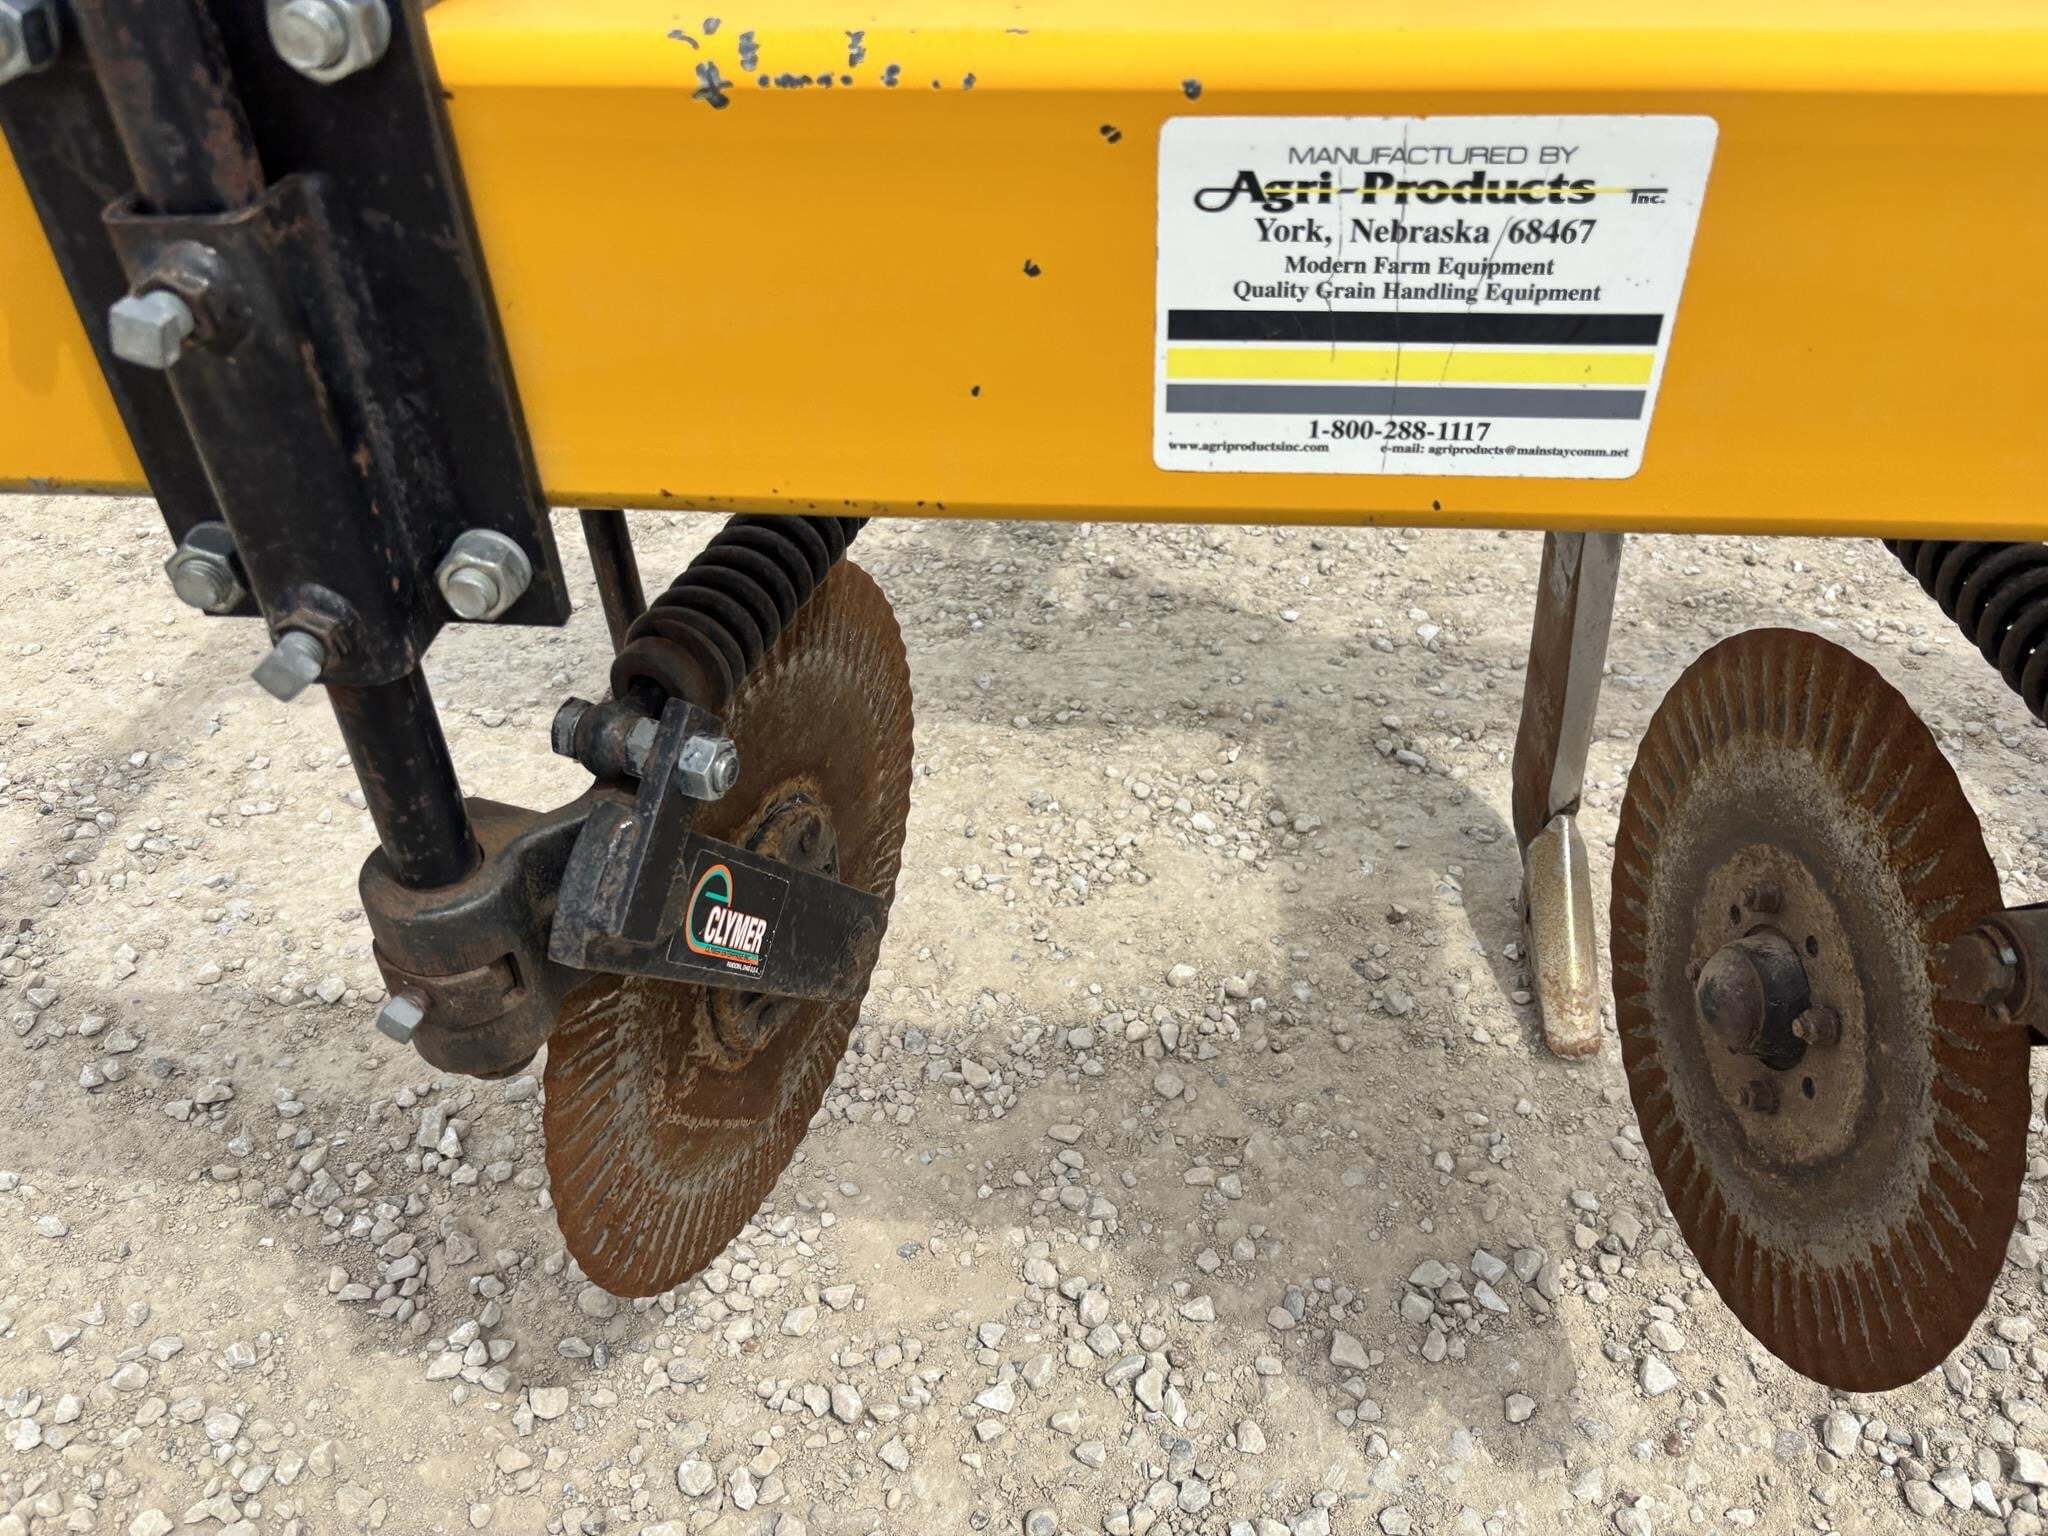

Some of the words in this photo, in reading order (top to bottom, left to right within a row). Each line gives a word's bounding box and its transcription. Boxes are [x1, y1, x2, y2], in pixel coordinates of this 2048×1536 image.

[1288, 146, 1528, 165] MANUFACTURED
[1539, 145, 1580, 165] BY
[1194, 170, 1597, 213] Agri-Products
[1255, 218, 1333, 247] York,
[1349, 218, 1490, 244] Nebraska
[1507, 219, 1597, 245] 68467
[1284, 256, 1366, 275] Modern
[1373, 257, 1431, 276] Farm
[1438, 257, 1554, 279] Equipment
[1233, 281, 1308, 301] Quality
[1316, 282, 1375, 300] Grain
[1383, 282, 1478, 304] Handling
[1485, 283, 1601, 305] Equipment
[1308, 419, 1491, 441] 1-800-288-1117
[1168, 441, 1330, 454] www.agriproductsinc.com
[1380, 443, 1425, 455] e-mail:
[1427, 445, 1630, 459] agriproducts@mainstaycomm.net
[704, 905, 767, 953] CLYMER
